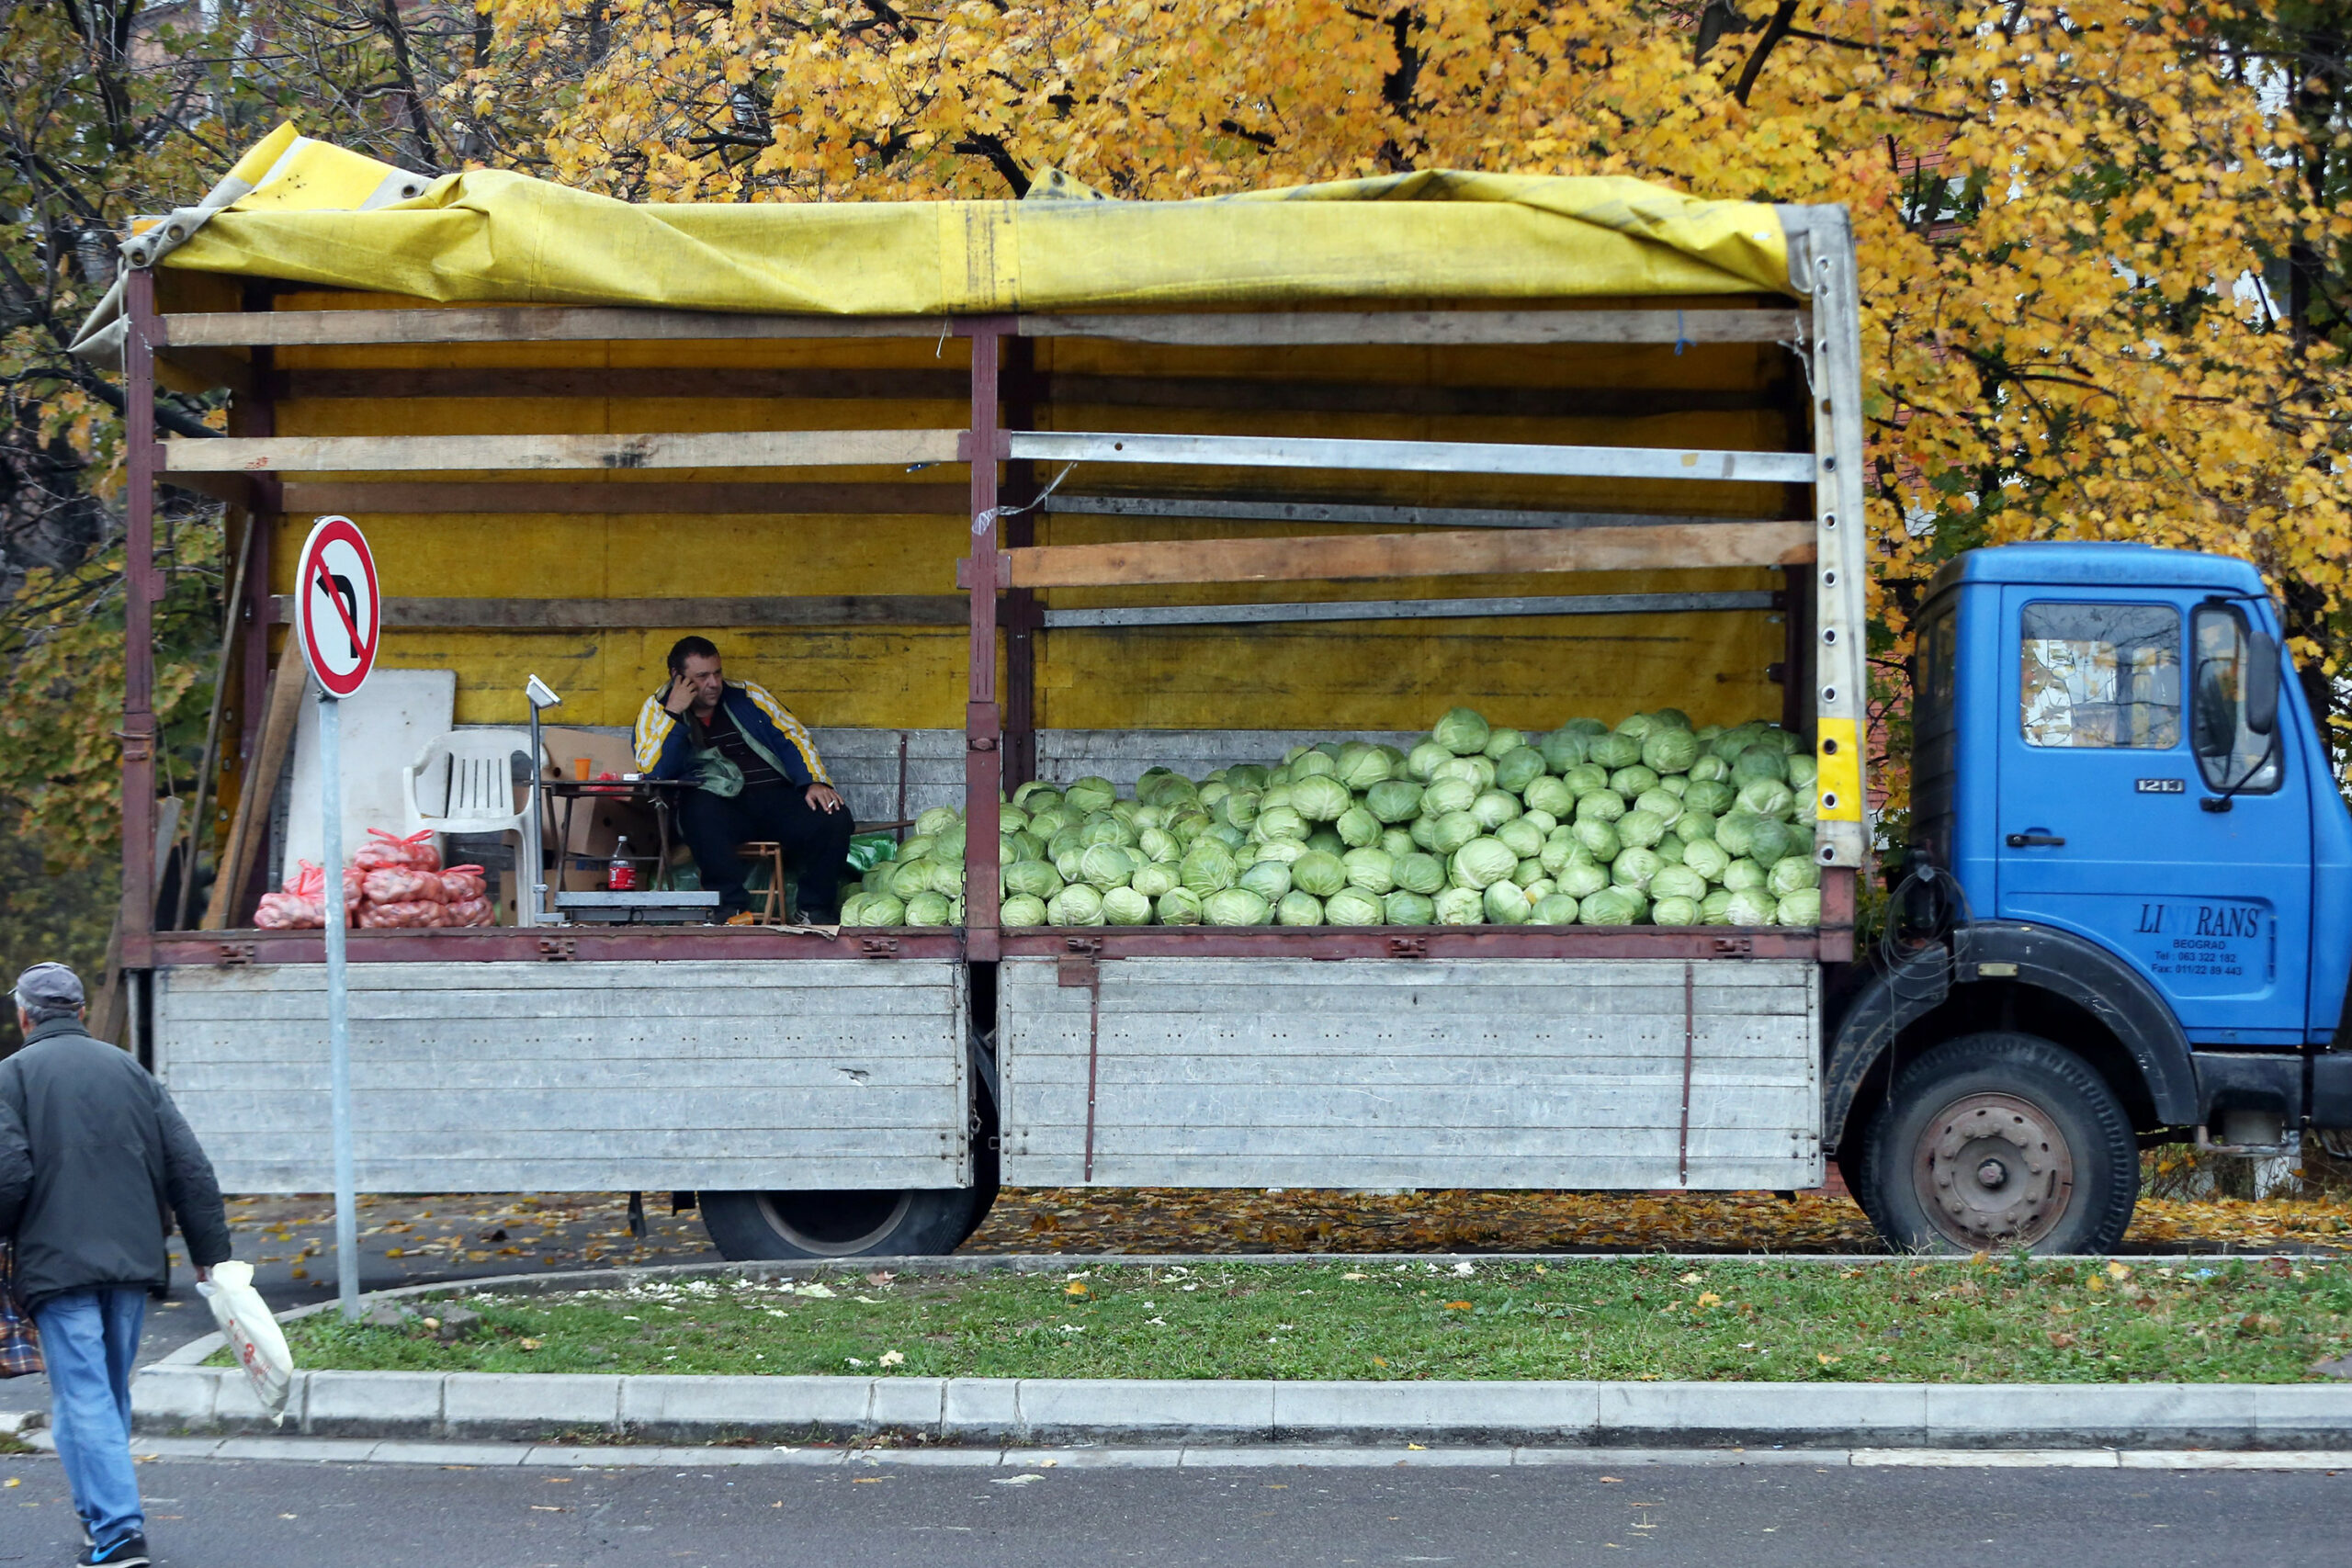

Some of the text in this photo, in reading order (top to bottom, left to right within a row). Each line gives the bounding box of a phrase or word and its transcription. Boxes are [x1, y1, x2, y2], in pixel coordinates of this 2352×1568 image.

[2173, 939, 2226, 950] BEOGRAD
[2154, 951, 2169, 961] Tel
[2178, 952, 2196, 962] 063
[2199, 953, 2216, 963] 322
[2219, 953, 2236, 963] 182
[2151, 964, 2172, 974] Fax:
[2176, 964, 2206, 975] 011/22
[2224, 966, 2243, 976] 443
